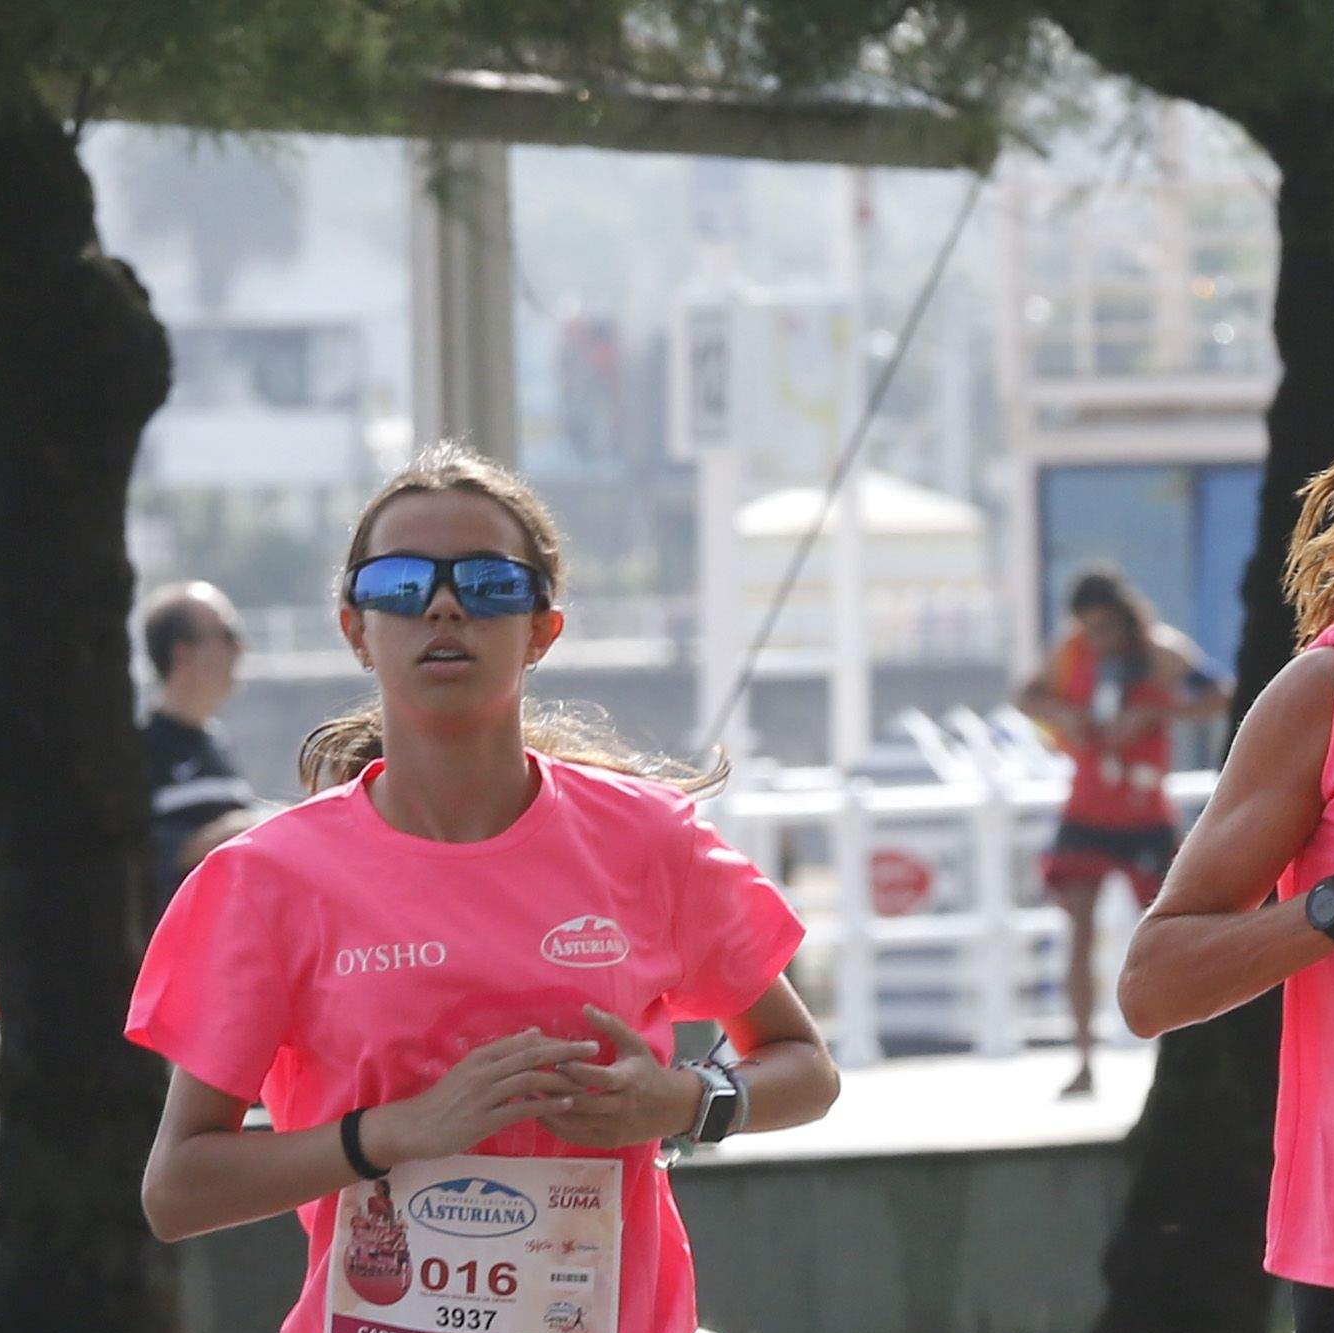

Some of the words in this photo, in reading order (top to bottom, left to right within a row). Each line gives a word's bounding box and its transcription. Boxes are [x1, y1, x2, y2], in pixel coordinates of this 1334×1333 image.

[335, 941, 447, 976] OYSHO
[418, 1196, 527, 1225] ASTURIANA
[548, 1195, 602, 1210] SUMA
[420, 1256, 518, 1296] 016
[435, 1306, 498, 1331] 3937
